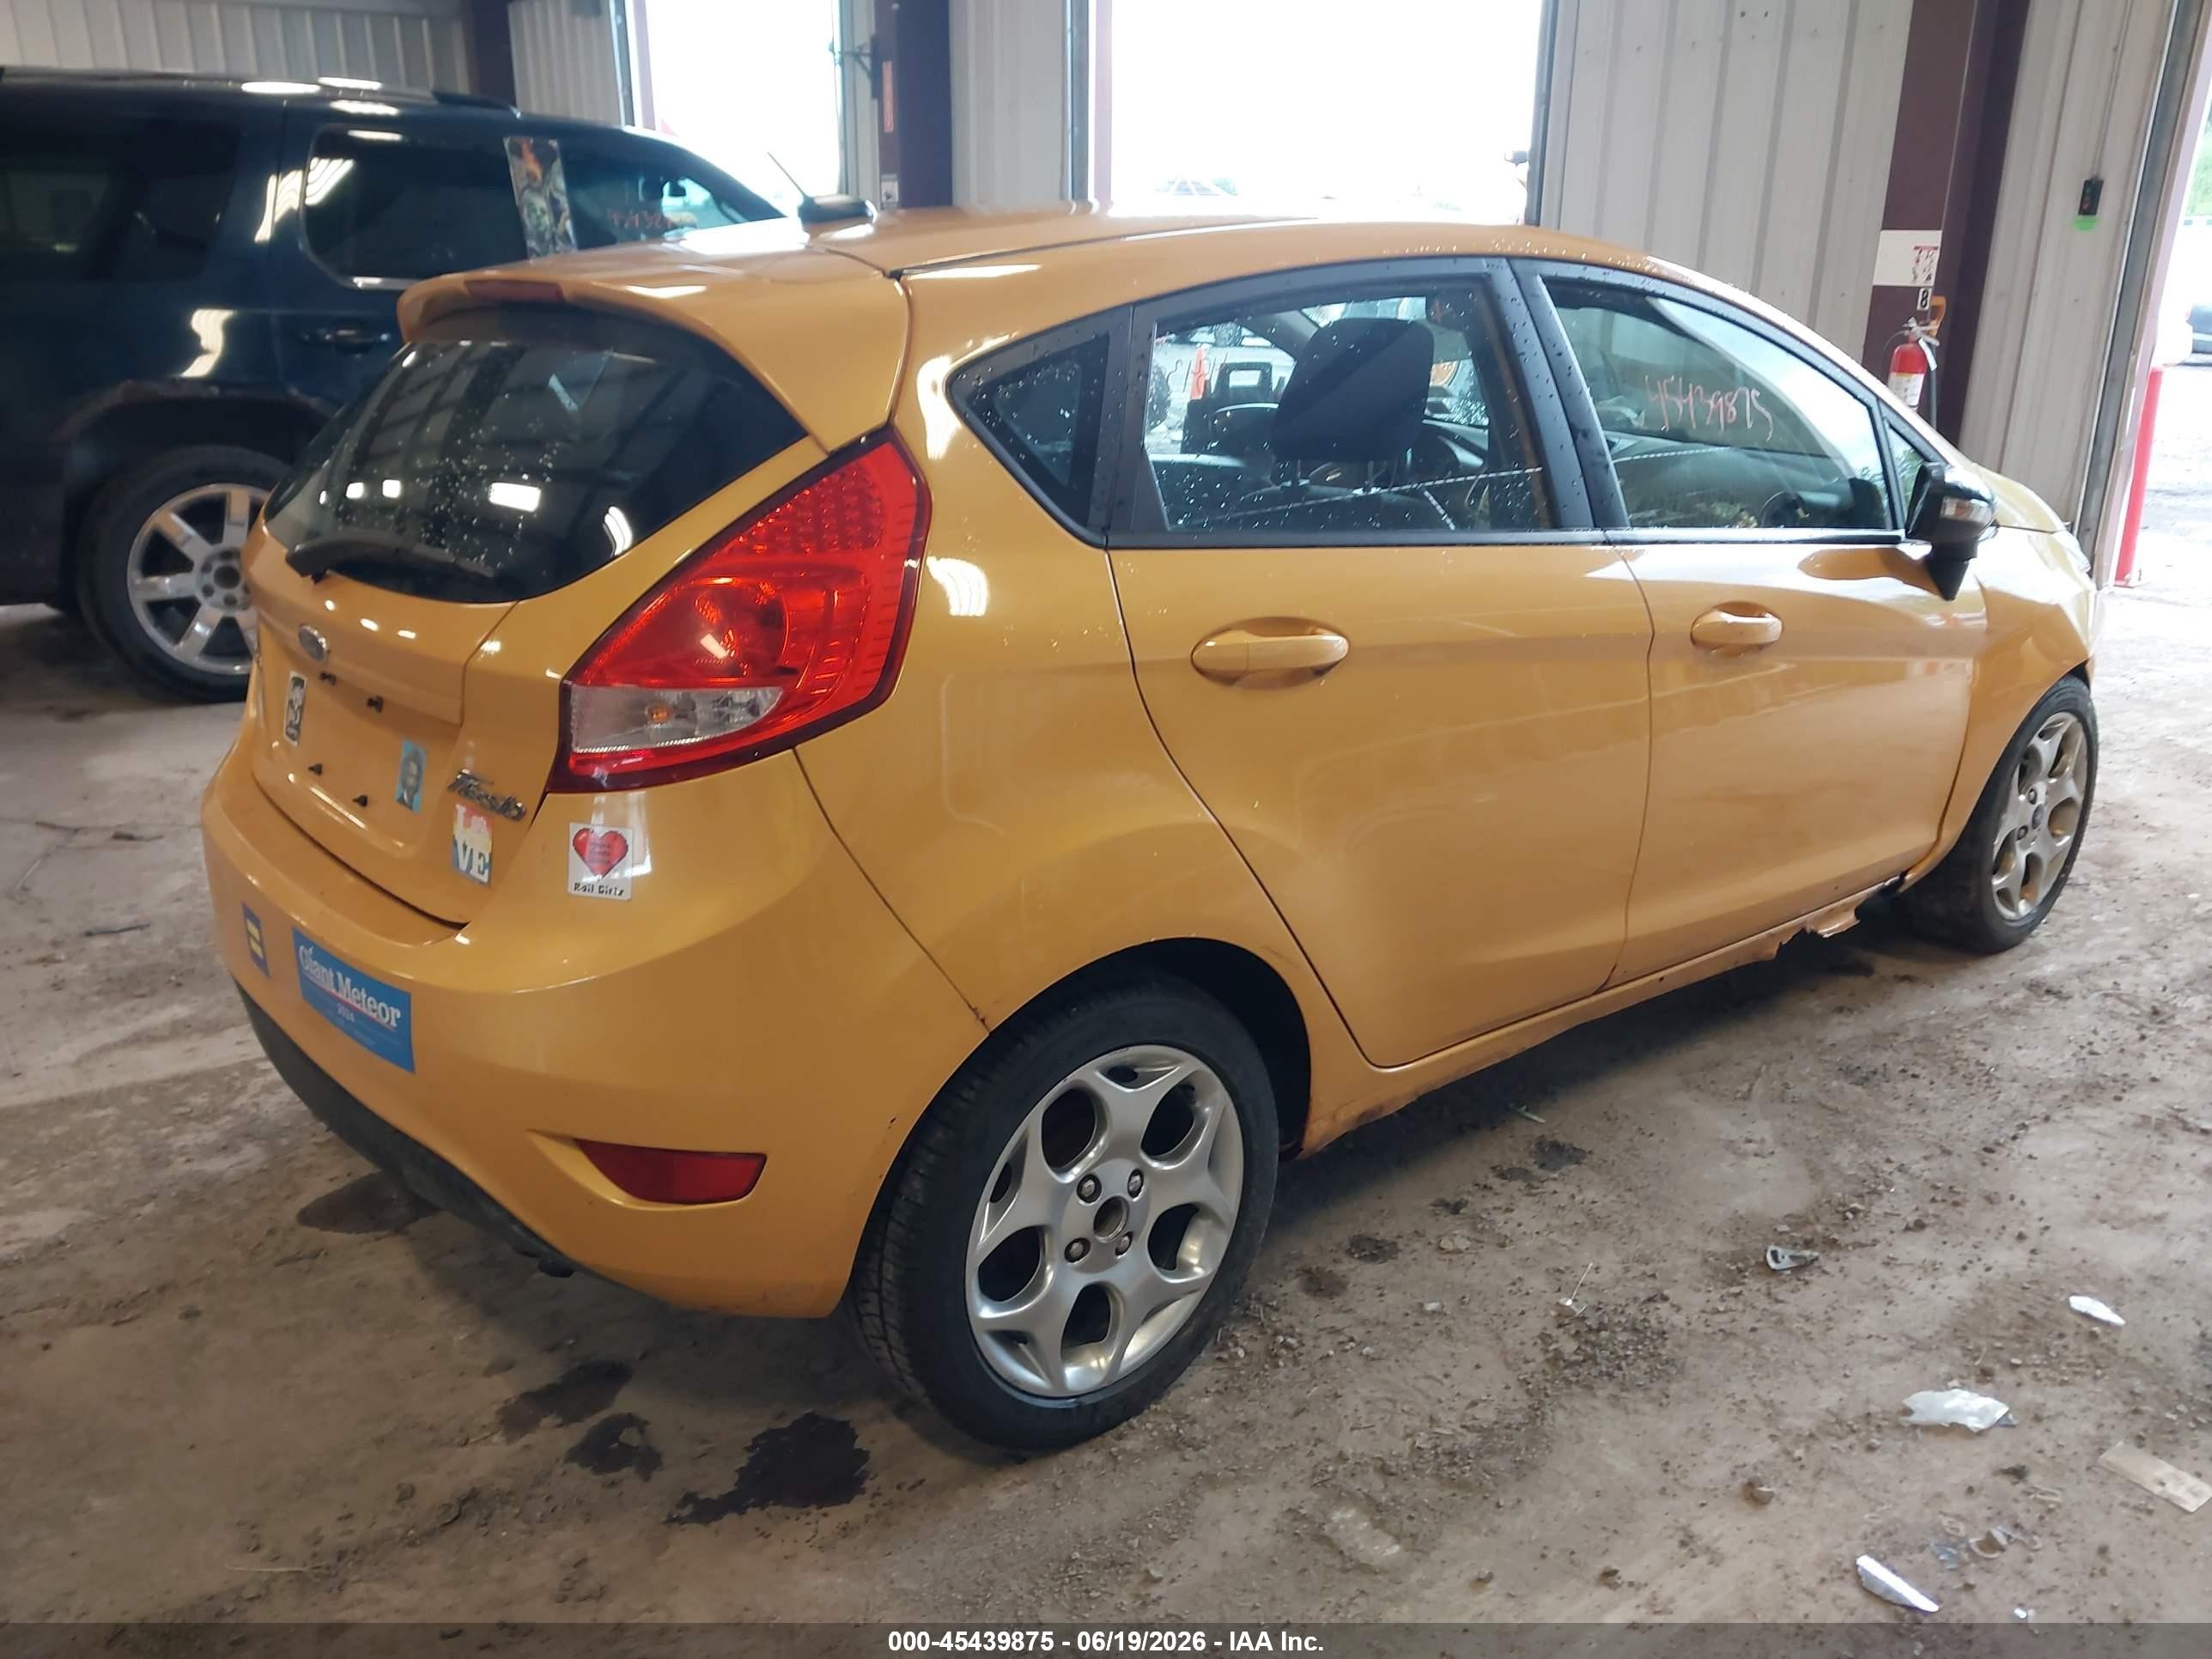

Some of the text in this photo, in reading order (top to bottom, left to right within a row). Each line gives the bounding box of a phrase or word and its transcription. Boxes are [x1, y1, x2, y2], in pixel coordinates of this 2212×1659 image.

[1920, 289, 1930, 309] 8
[1644, 374, 1774, 442] 45439875
[598, 884, 624, 896] Girls
[298, 945, 402, 1028] Giant Meteor
